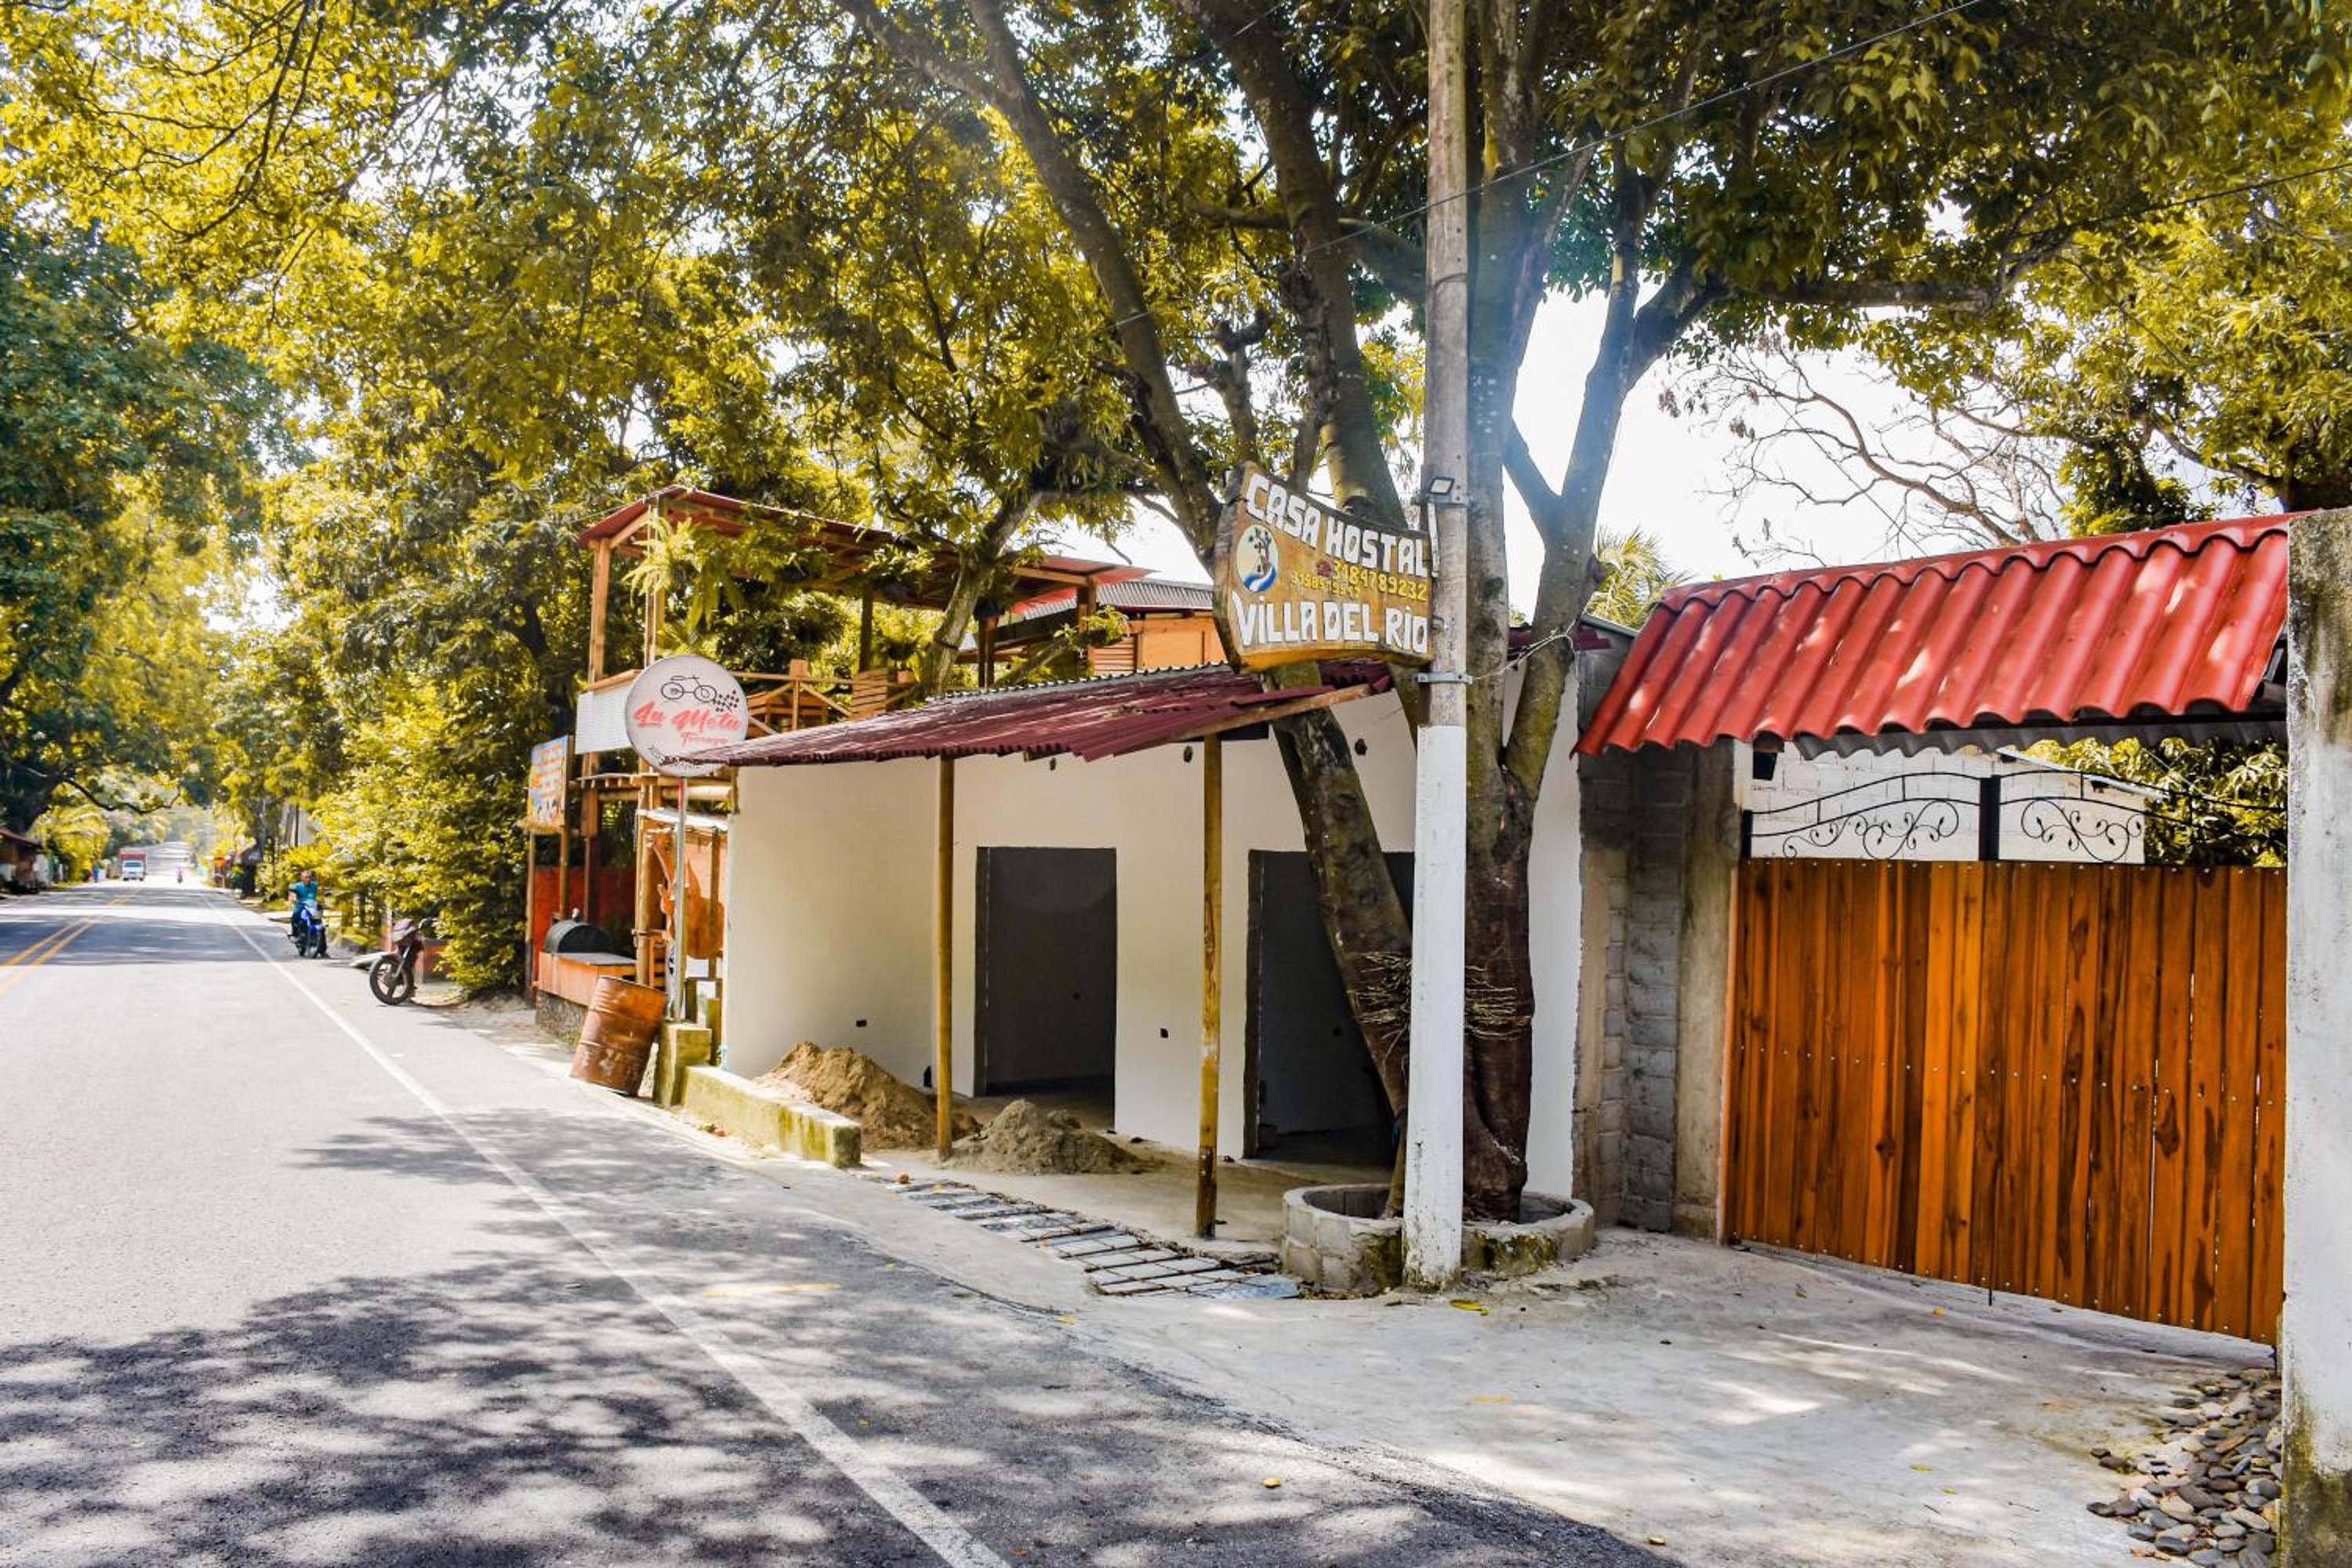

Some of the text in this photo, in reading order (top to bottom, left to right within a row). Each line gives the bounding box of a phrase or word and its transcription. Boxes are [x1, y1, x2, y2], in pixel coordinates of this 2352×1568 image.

[1246, 473, 1428, 577] CASA HOSTAL
[1323, 601, 1379, 642] DEL
